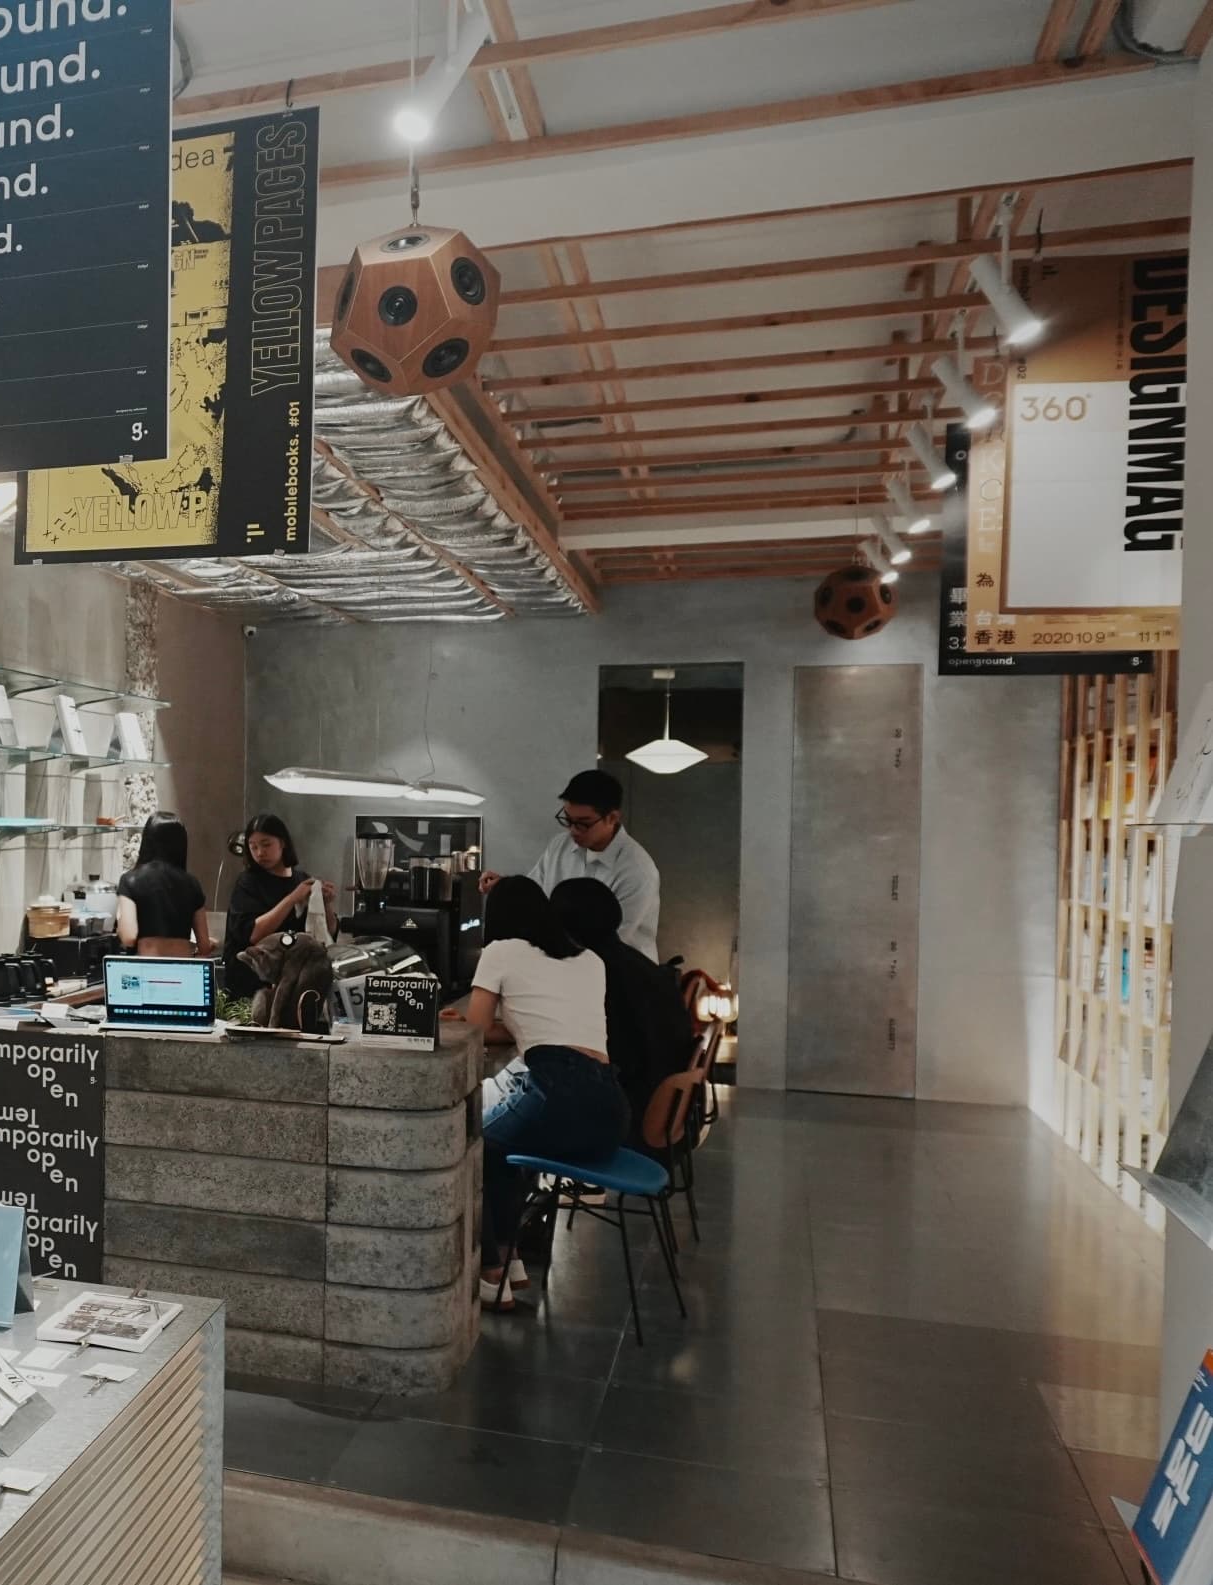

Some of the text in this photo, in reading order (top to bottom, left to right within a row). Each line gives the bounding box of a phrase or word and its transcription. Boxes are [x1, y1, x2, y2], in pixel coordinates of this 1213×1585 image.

[172, 146, 215, 171] dea
[251, 121, 307, 397] YELLOW PAGES
[283, 401, 300, 542] mobilebooks. #01
[367, 976, 436, 993] Temporarily
[397, 989, 424, 1010] open
[27, 1063, 78, 1107] open
[26, 1148, 78, 1193] open
[26, 1214, 99, 1243] orarily
[27, 1233, 77, 1279] open
